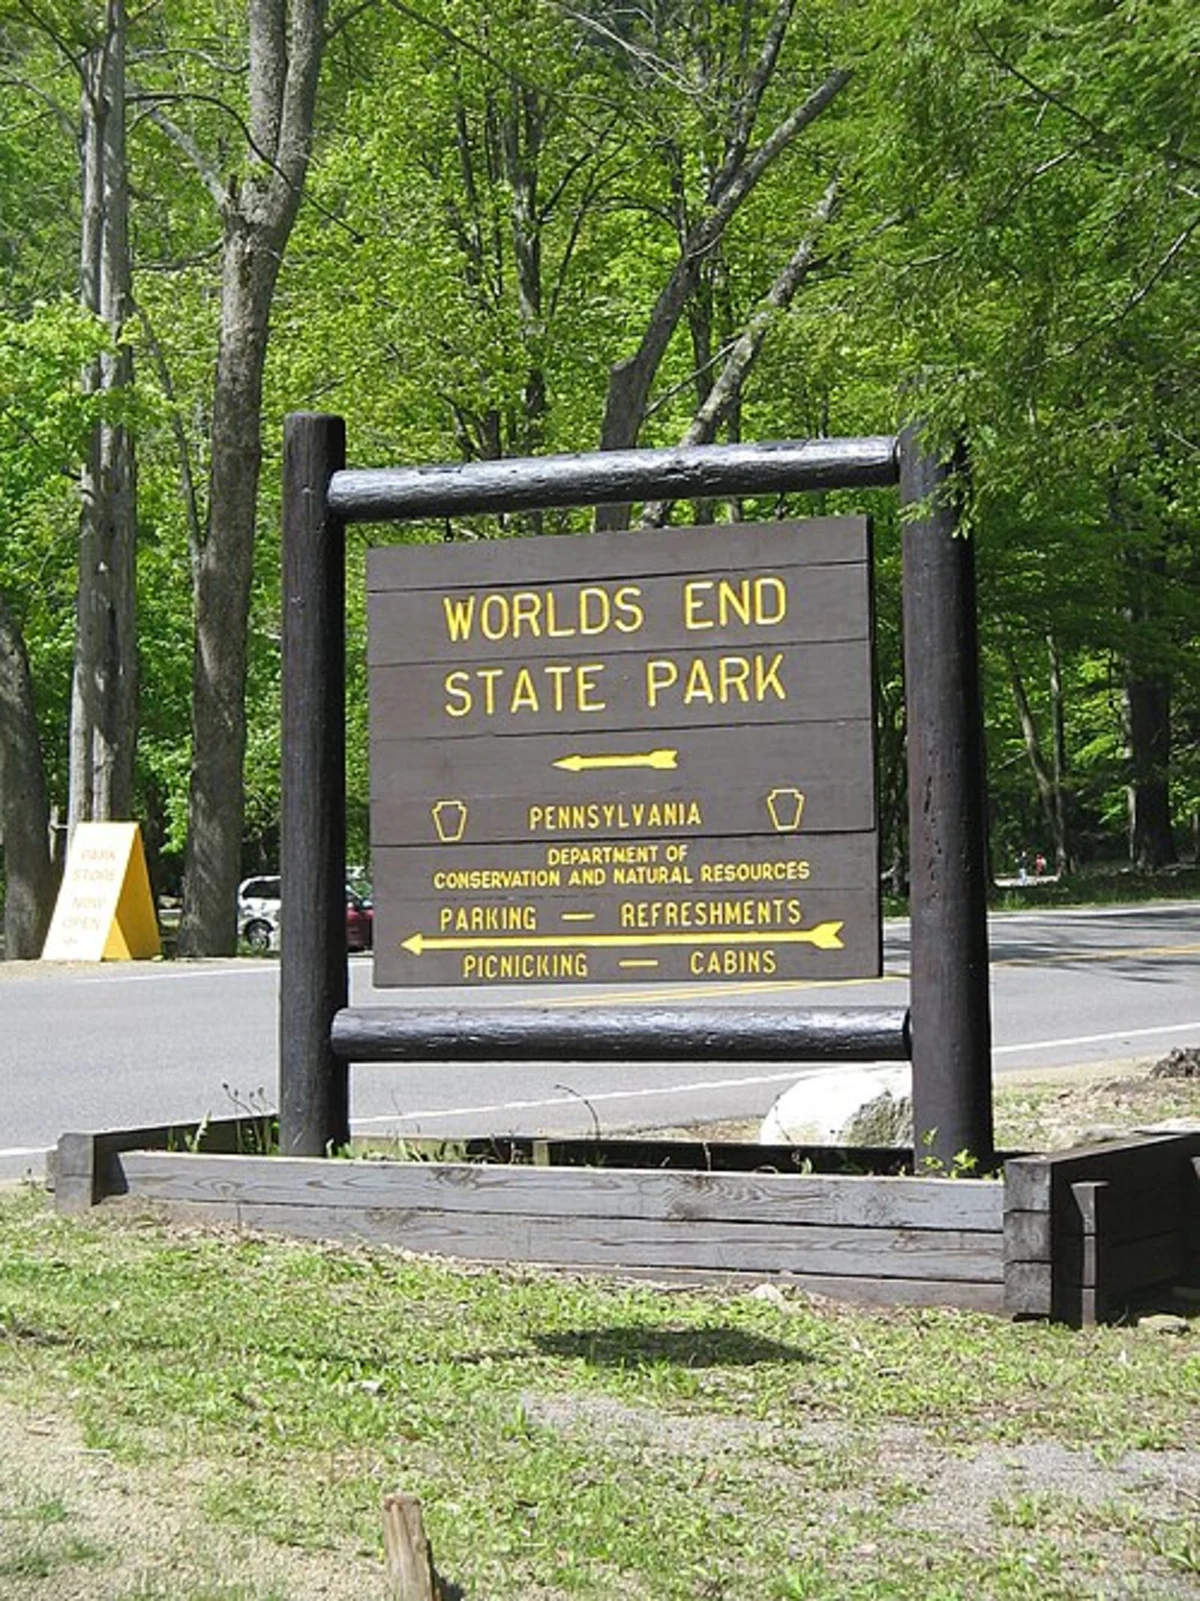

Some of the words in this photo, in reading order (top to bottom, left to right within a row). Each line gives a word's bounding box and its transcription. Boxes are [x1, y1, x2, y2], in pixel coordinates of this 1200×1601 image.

[443, 585, 644, 641] WORLDS
[684, 577, 788, 629] END
[444, 662, 604, 716] STATE
[646, 653, 786, 706] PARK
[528, 803, 702, 829] PENNSYLVANIA
[547, 846, 660, 866] DEPARTMENT
[666, 844, 688, 863] OF
[433, 867, 560, 889] CONSERVATION
[568, 868, 606, 886] AND
[612, 864, 694, 885] NATURAL
[700, 861, 811, 881] RESOURCES
[439, 905, 537, 931] PARKING
[620, 898, 801, 926] REFRESHMENTS
[462, 953, 588, 979] PICNICKING
[690, 950, 776, 974] CABINS
